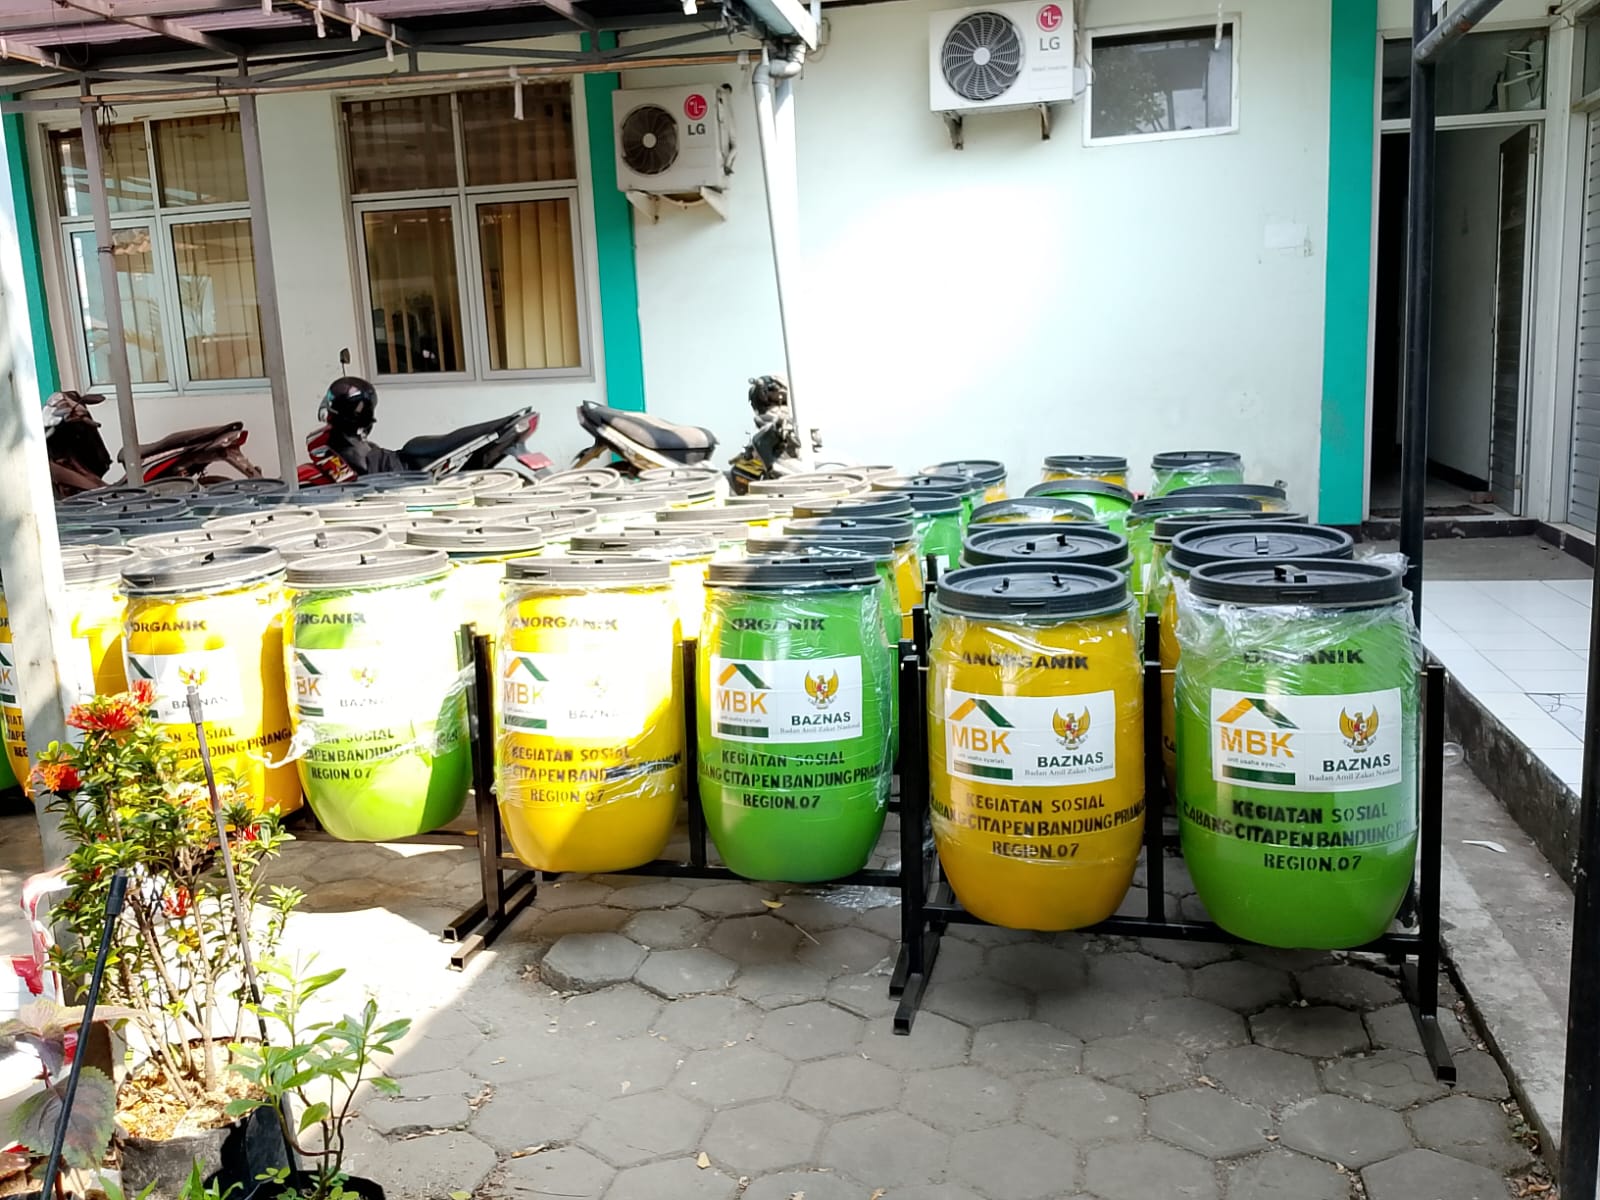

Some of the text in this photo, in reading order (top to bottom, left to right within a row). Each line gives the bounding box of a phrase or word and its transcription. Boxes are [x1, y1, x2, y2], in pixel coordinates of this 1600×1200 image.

[1040, 36, 1061, 51] LG
[688, 123, 706, 136] LG
[718, 689, 768, 715] MBK
[791, 711, 851, 726] BAZNAS
[187, 727, 236, 741] SSIAL
[951, 724, 1012, 755] MBK
[1221, 726, 1296, 759] MBK
[722, 749, 845, 767] KEGIATAN SOSIAL
[1037, 751, 1104, 768] BAZNAS
[1323, 754, 1392, 773] BAZNAS
[966, 792, 1105, 814] KEGIATAN SOSIAL
[1232, 799, 1388, 824] KEGIATAN SOSIAL
